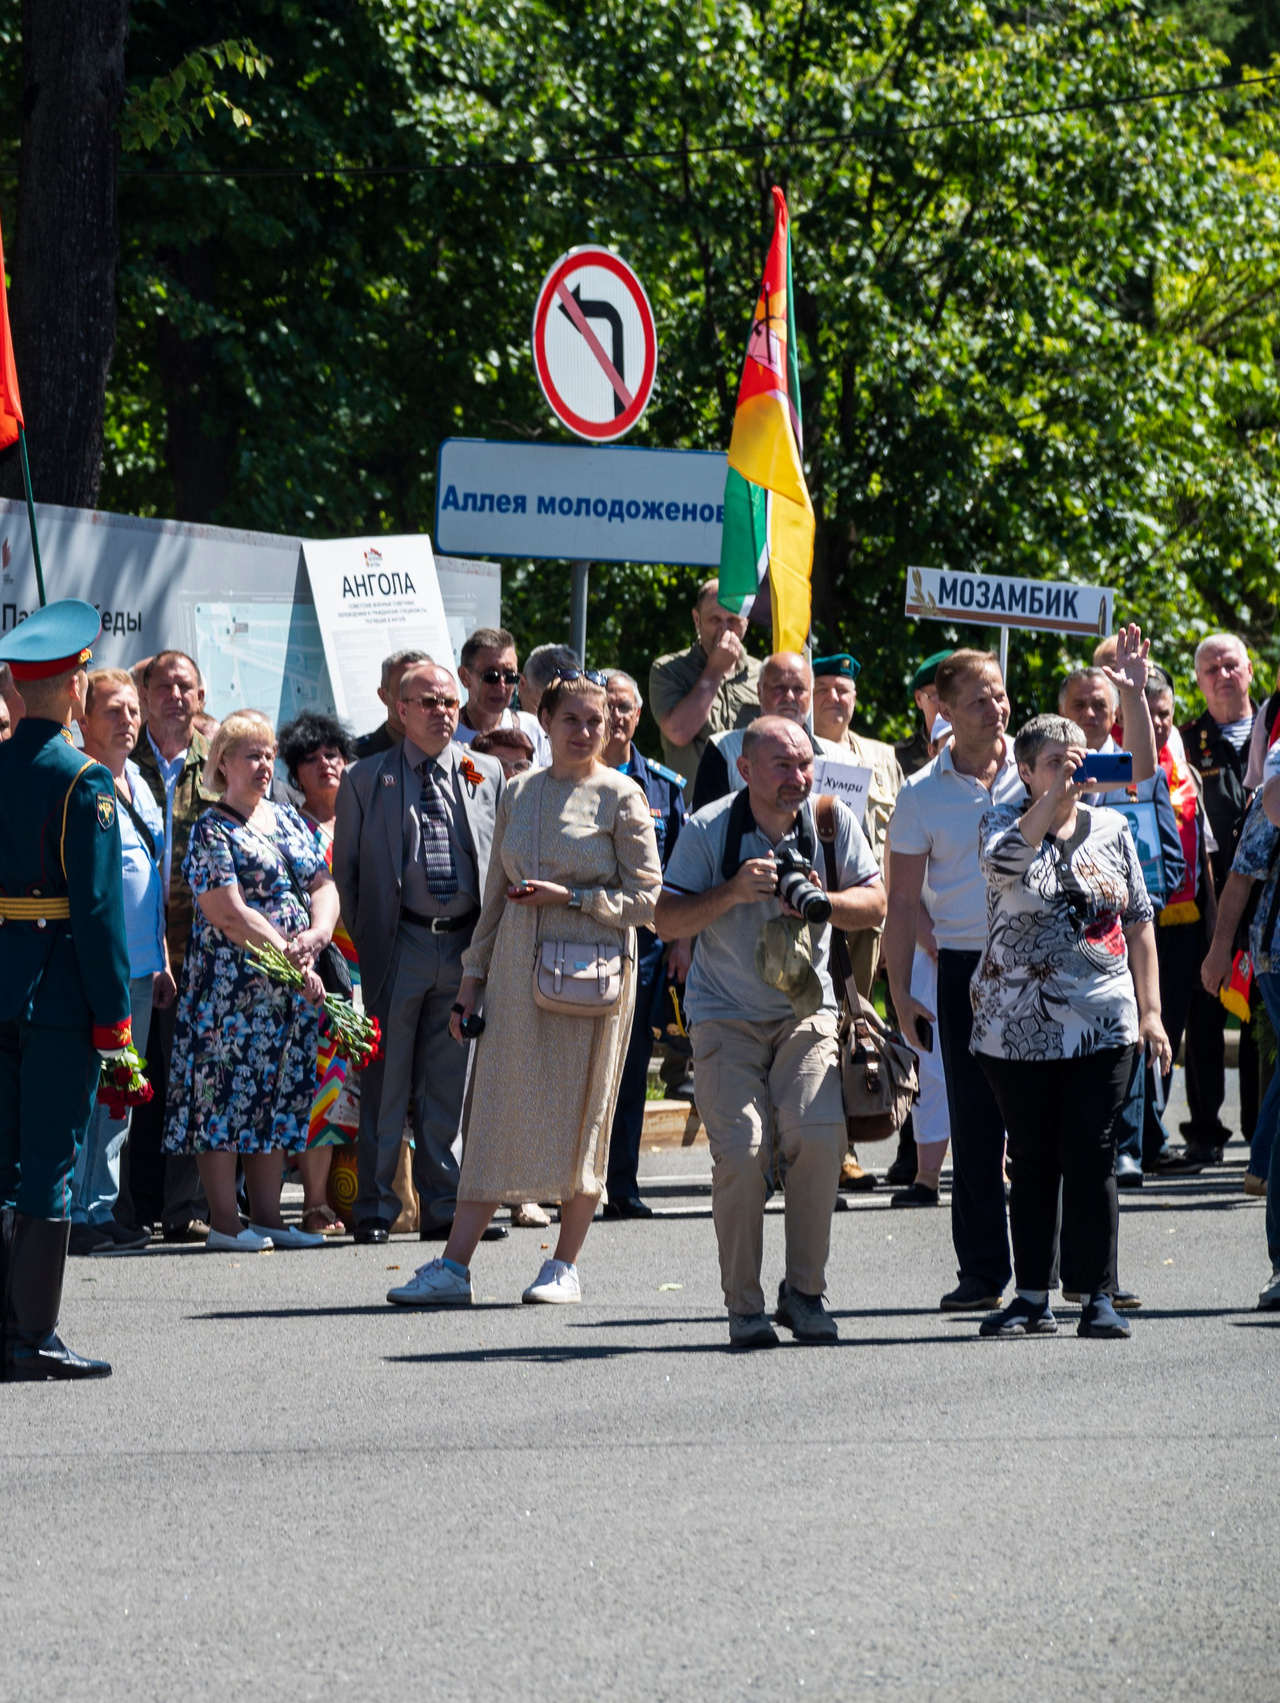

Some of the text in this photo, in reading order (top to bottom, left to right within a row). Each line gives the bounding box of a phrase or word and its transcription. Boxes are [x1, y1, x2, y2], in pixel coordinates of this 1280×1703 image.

[441, 484, 527, 515] Аллея
[342, 571, 417, 598] АНГОЛА
[938, 576, 1079, 619] МОЗАМБИК
[824, 776, 864, 793] Хумри
